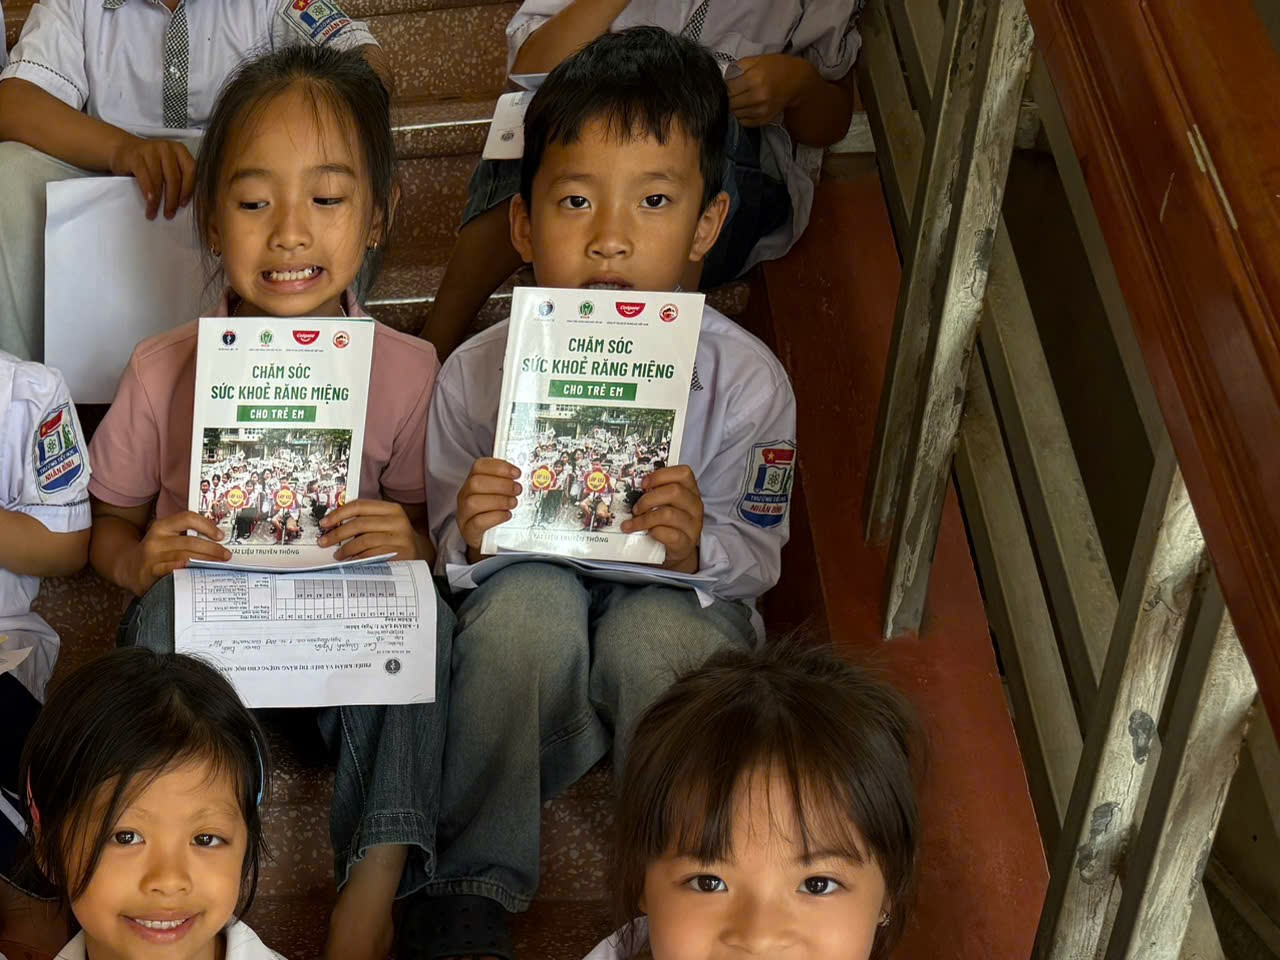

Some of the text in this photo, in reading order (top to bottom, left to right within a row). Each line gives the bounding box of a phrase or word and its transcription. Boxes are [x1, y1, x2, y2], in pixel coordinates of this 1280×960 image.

[568, 336, 633, 354] CHĂM SÓC
[252, 363, 311, 379] CHĂM SÓC
[522, 355, 674, 382] SỨC KHOẺ RĂNG MIỆNG
[211, 382, 349, 404] SỨC KHOẺ RĂNG MIỆNG
[563, 383, 623, 396] CHO TRẺ EM
[250, 407, 305, 419] CHO TRẺ EM
